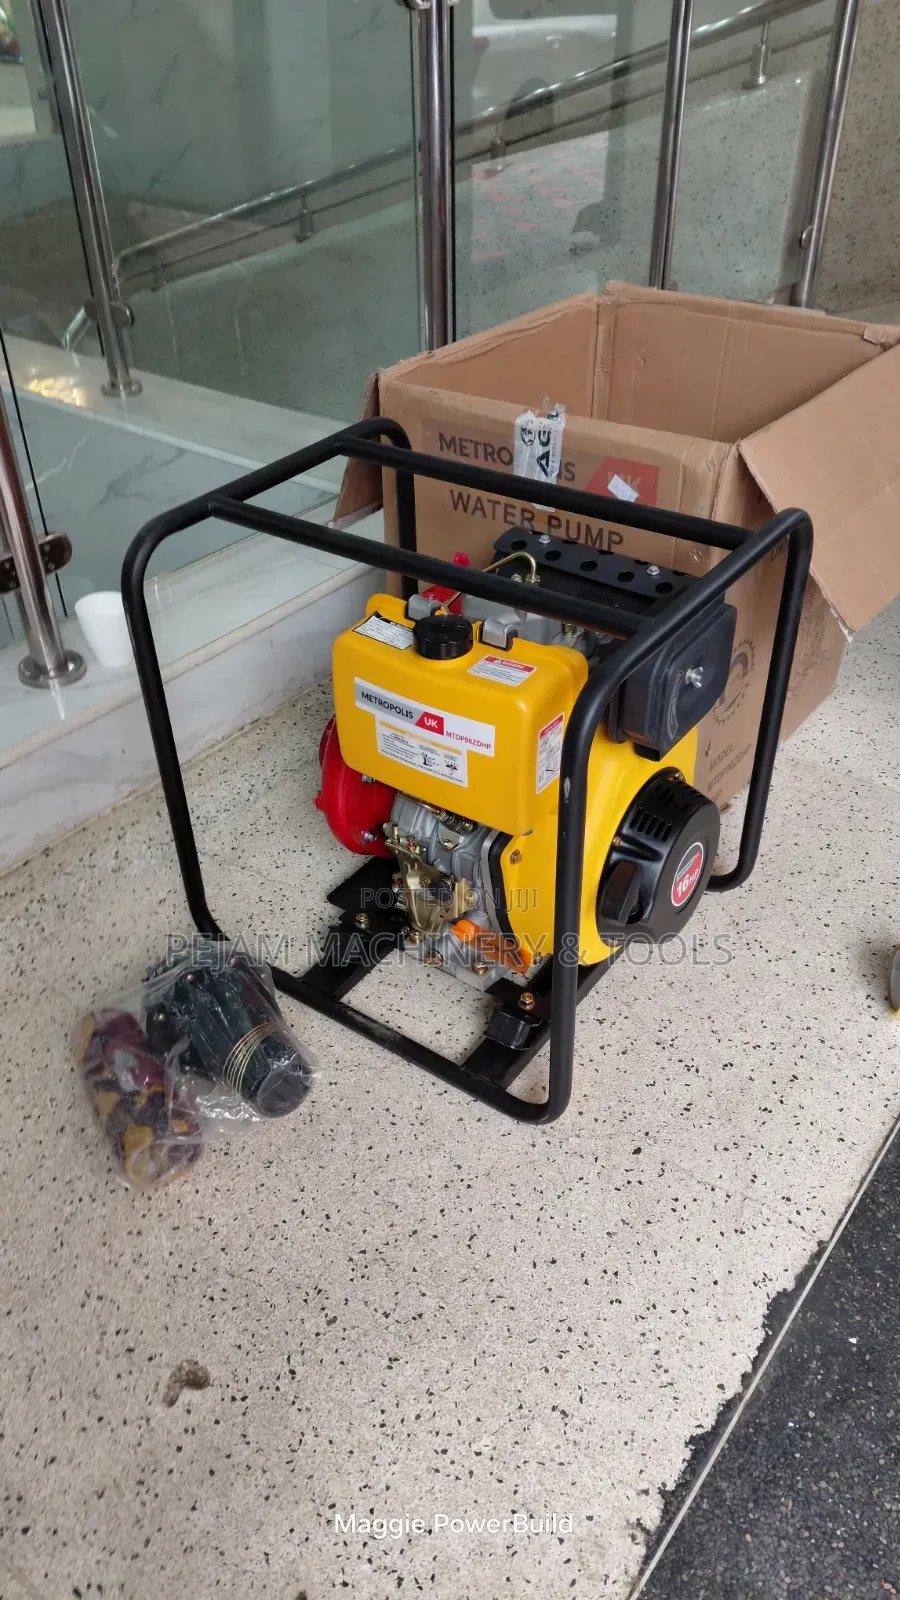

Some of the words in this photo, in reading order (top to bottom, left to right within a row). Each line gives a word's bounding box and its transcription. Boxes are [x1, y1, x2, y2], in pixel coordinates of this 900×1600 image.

[438, 432, 576, 482] METROIS
[449, 489, 535, 530] WATER
[547, 514, 624, 551] PUMP
[361, 691, 414, 719] METROPOLIS
[423, 716, 439, 729] UK
